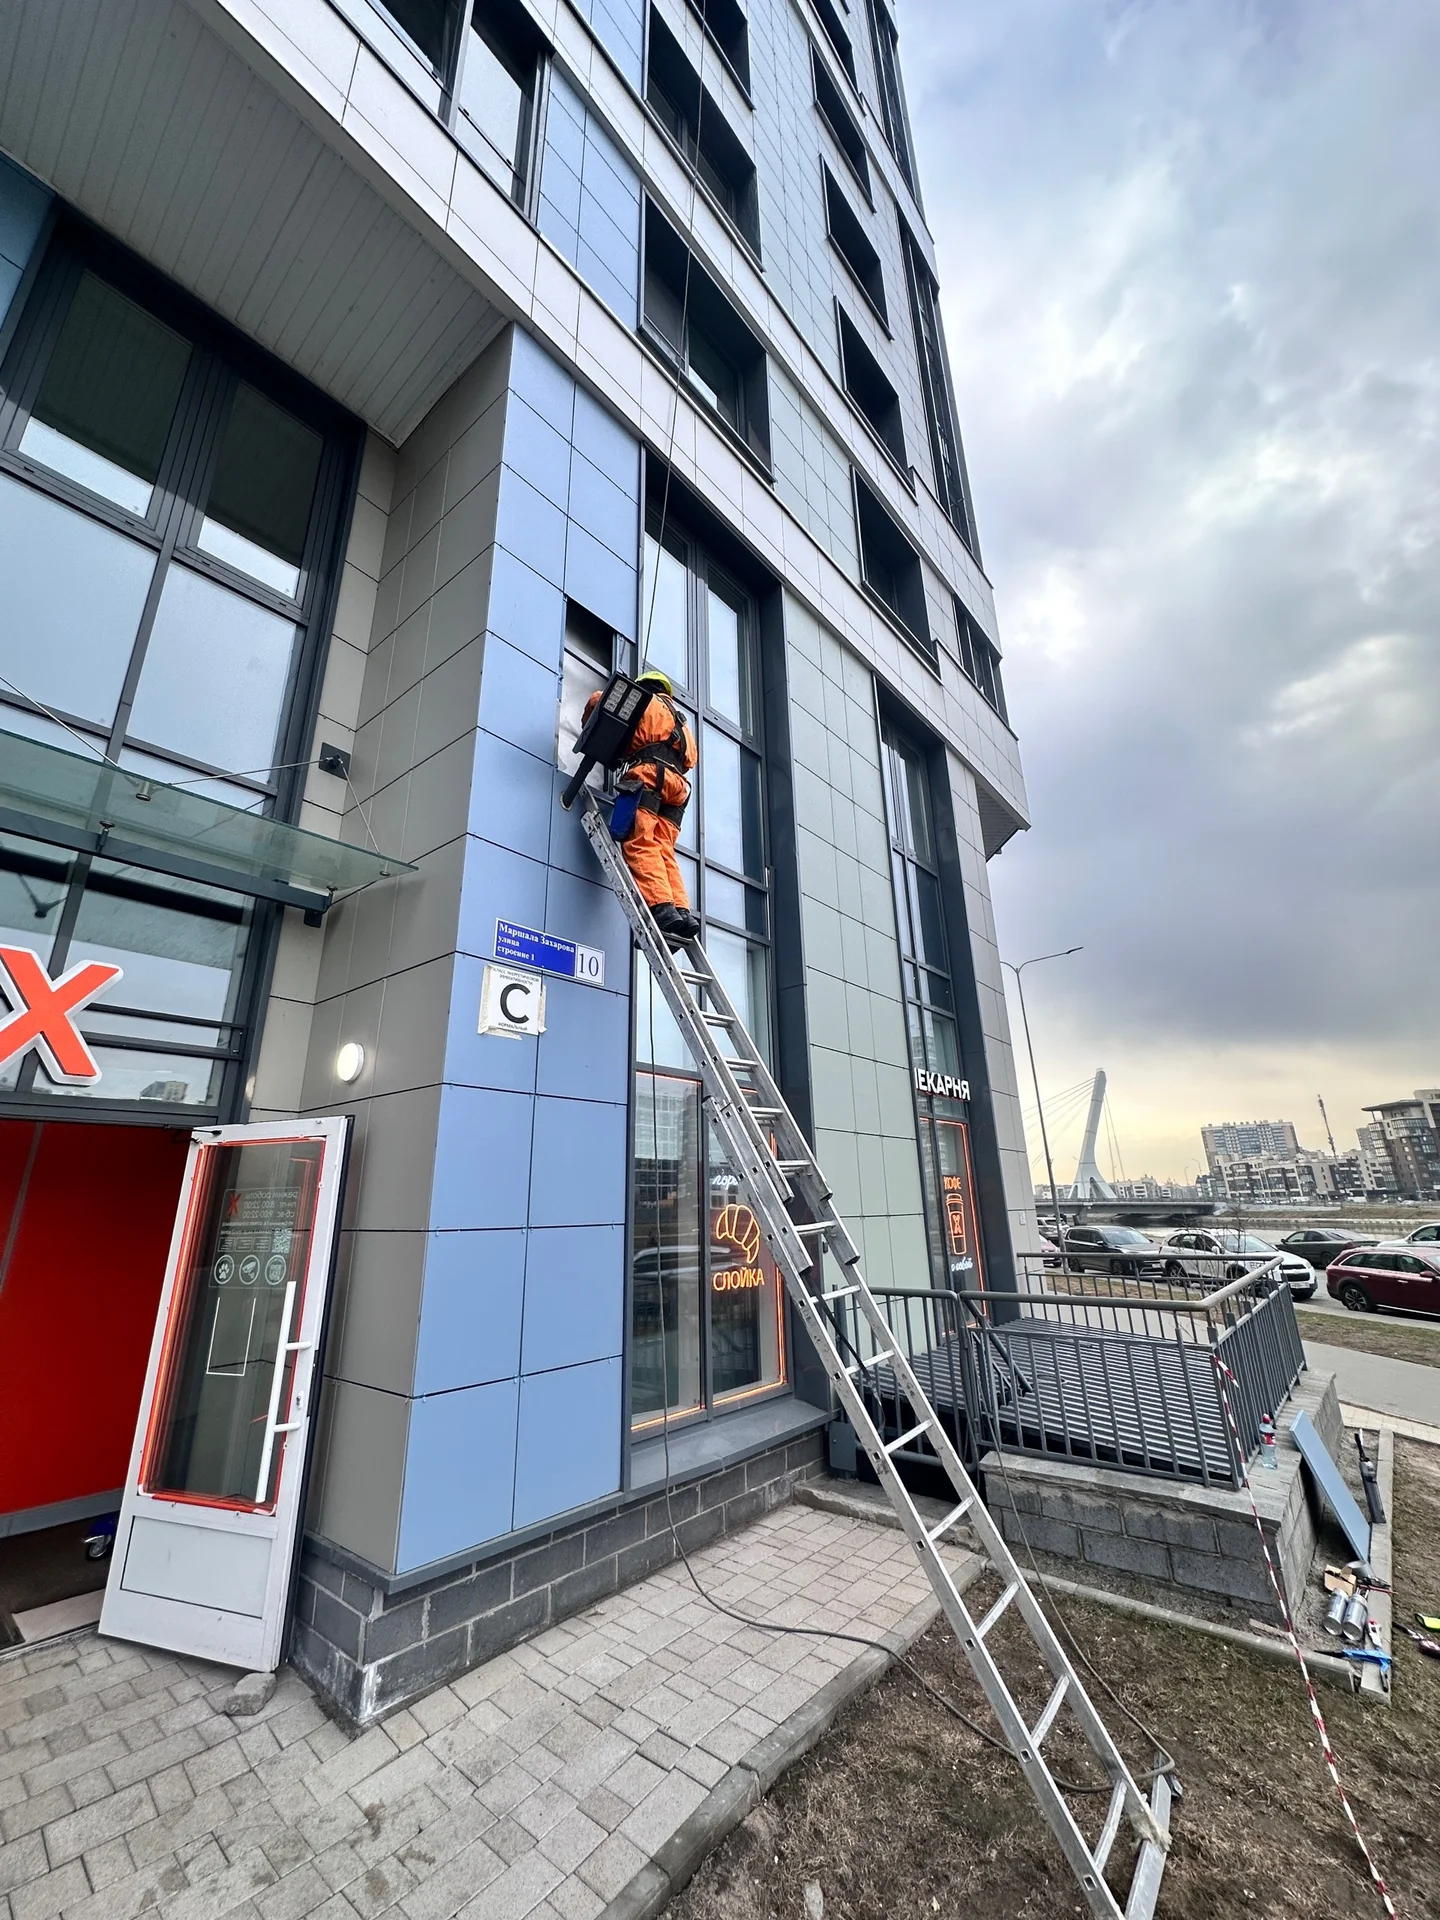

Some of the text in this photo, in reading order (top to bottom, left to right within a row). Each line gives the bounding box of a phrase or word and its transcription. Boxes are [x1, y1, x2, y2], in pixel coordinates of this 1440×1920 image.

[497, 934, 520, 947] улица
[499, 922, 575, 953] Маршала Захарова
[497, 945, 535, 961] строение 1
[578, 953, 599, 977] 10
[943, 1176, 962, 1190] КОФЕ
[713, 1267, 765, 1291] СЛОЙКА
